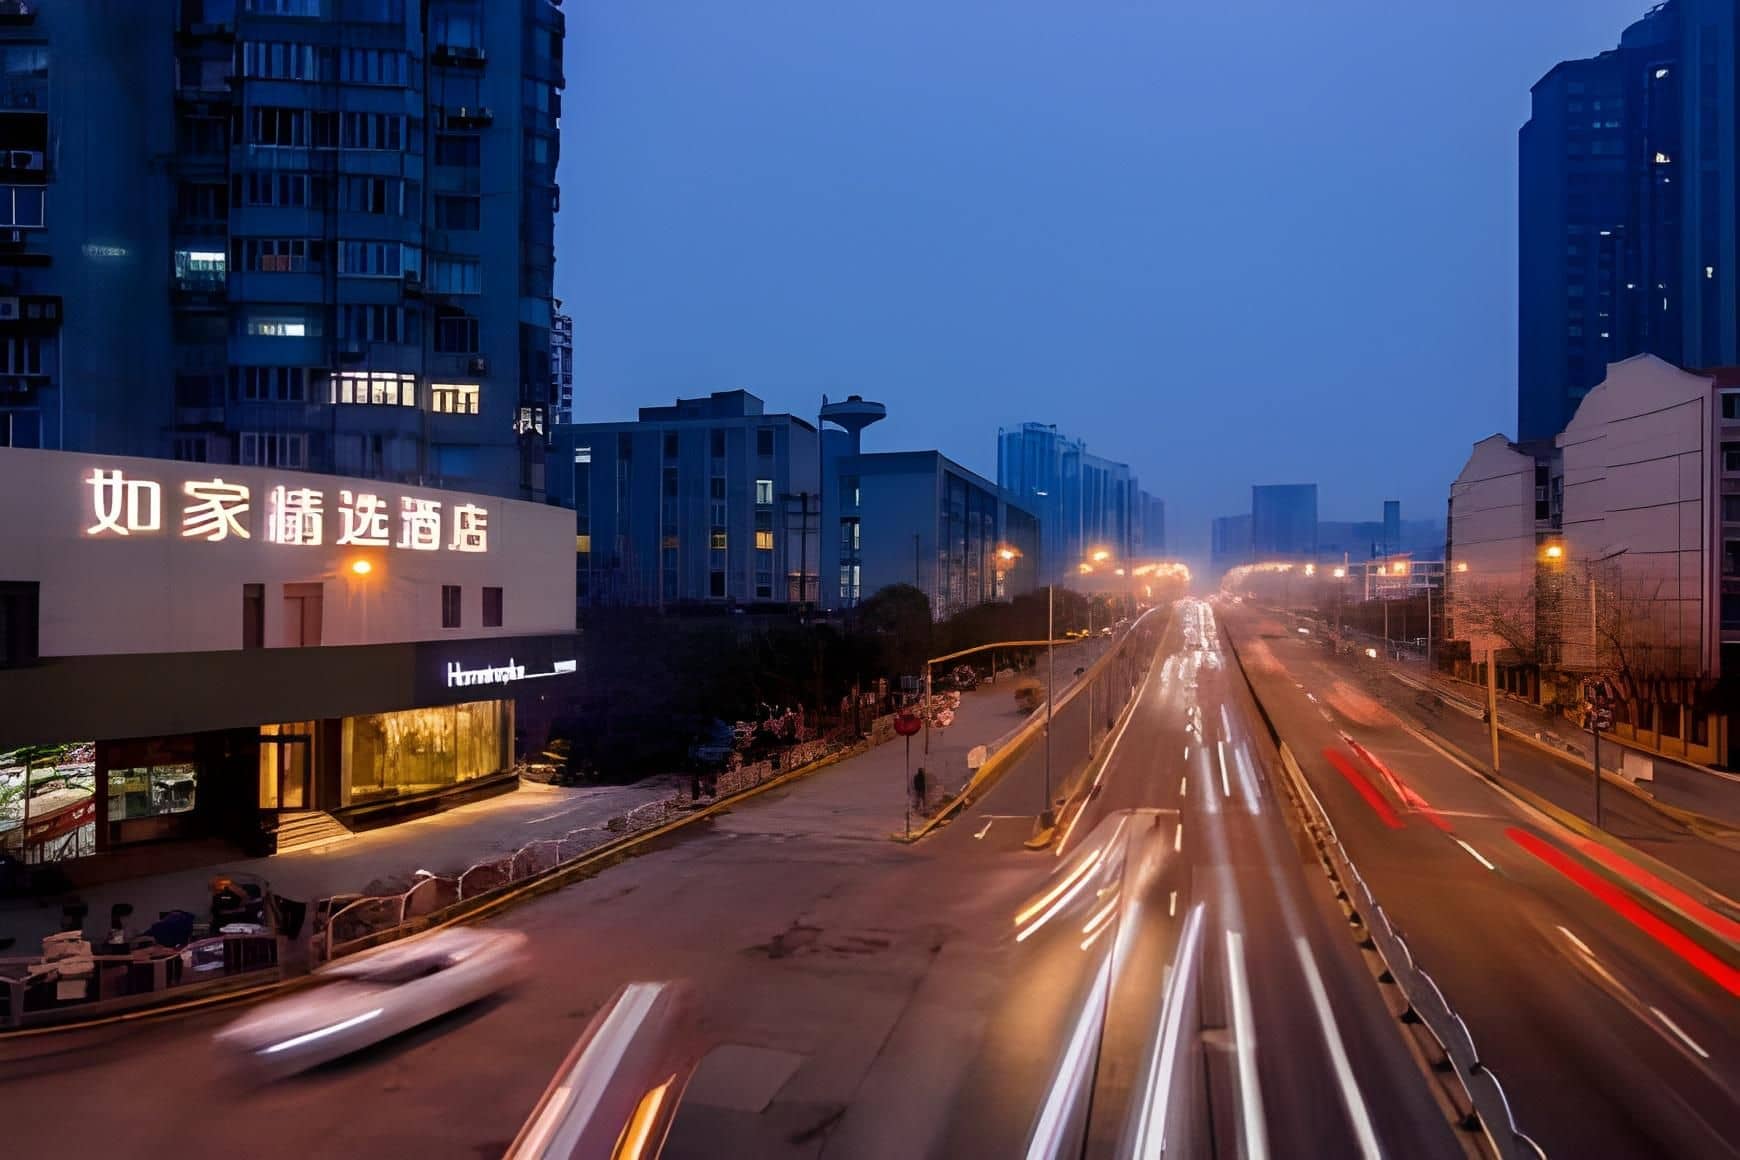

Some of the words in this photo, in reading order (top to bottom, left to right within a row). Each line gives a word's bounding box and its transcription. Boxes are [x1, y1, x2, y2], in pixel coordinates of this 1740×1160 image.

[85, 467, 488, 553] 如家精选酒店
